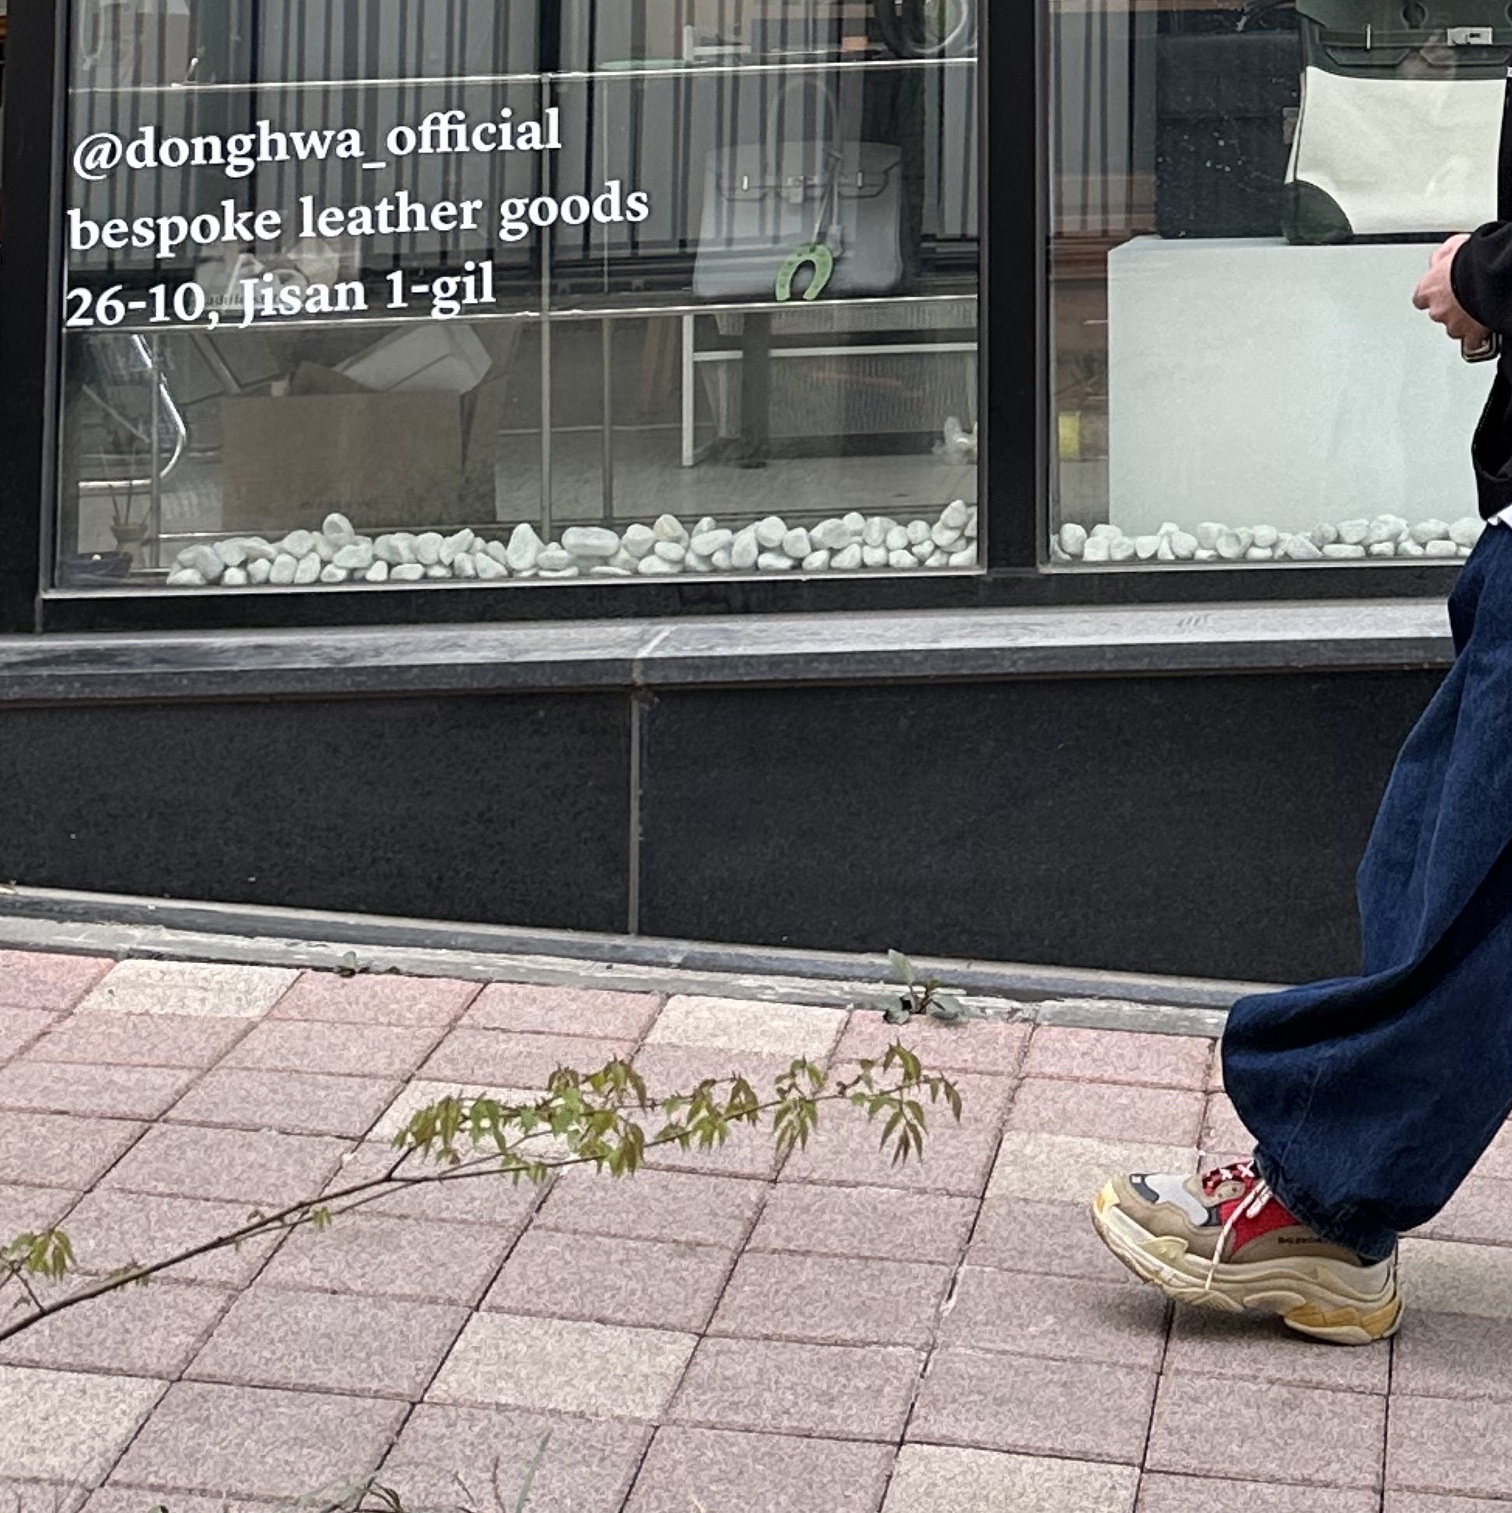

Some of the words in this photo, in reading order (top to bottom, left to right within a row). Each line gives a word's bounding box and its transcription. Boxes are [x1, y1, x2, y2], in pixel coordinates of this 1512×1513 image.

[73, 107, 562, 180] @donghwa_official
[67, 199, 282, 258] bespoke
[299, 191, 483, 238] leather
[498, 180, 650, 242] goods
[66, 282, 220, 330] 26-10,
[239, 273, 368, 329] Jisan
[386, 262, 497, 319] 1-gil
